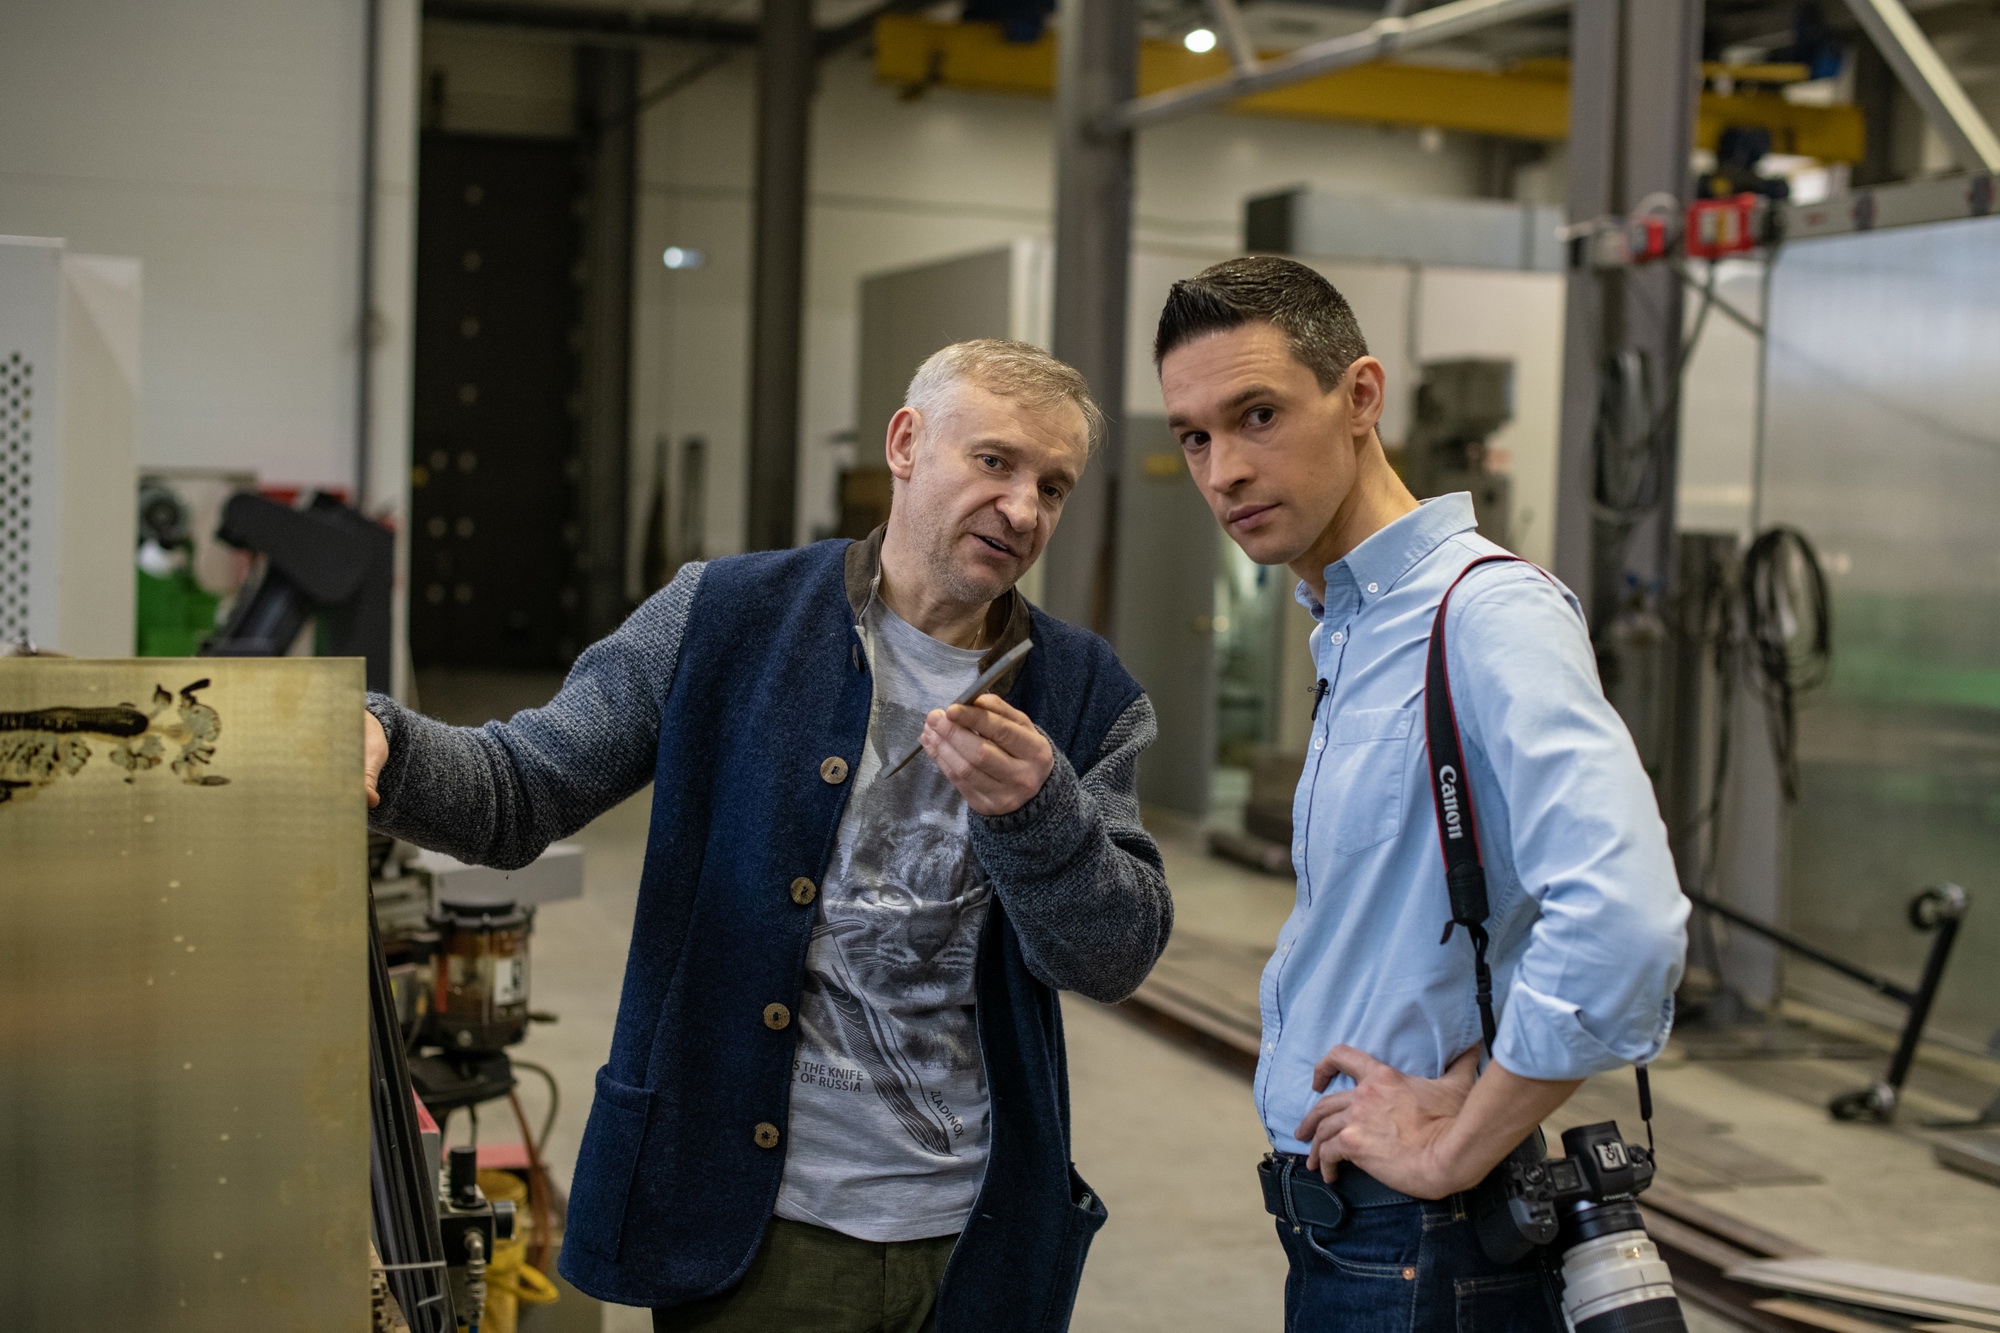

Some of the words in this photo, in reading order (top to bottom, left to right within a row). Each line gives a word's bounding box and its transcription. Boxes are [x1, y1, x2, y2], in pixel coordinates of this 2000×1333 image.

[1439, 764, 1463, 840] Canon
[803, 1061, 826, 1075] THE
[828, 1066, 864, 1081] KNIFE
[800, 1072, 816, 1084] OF
[818, 1076, 861, 1092] RUSSIA
